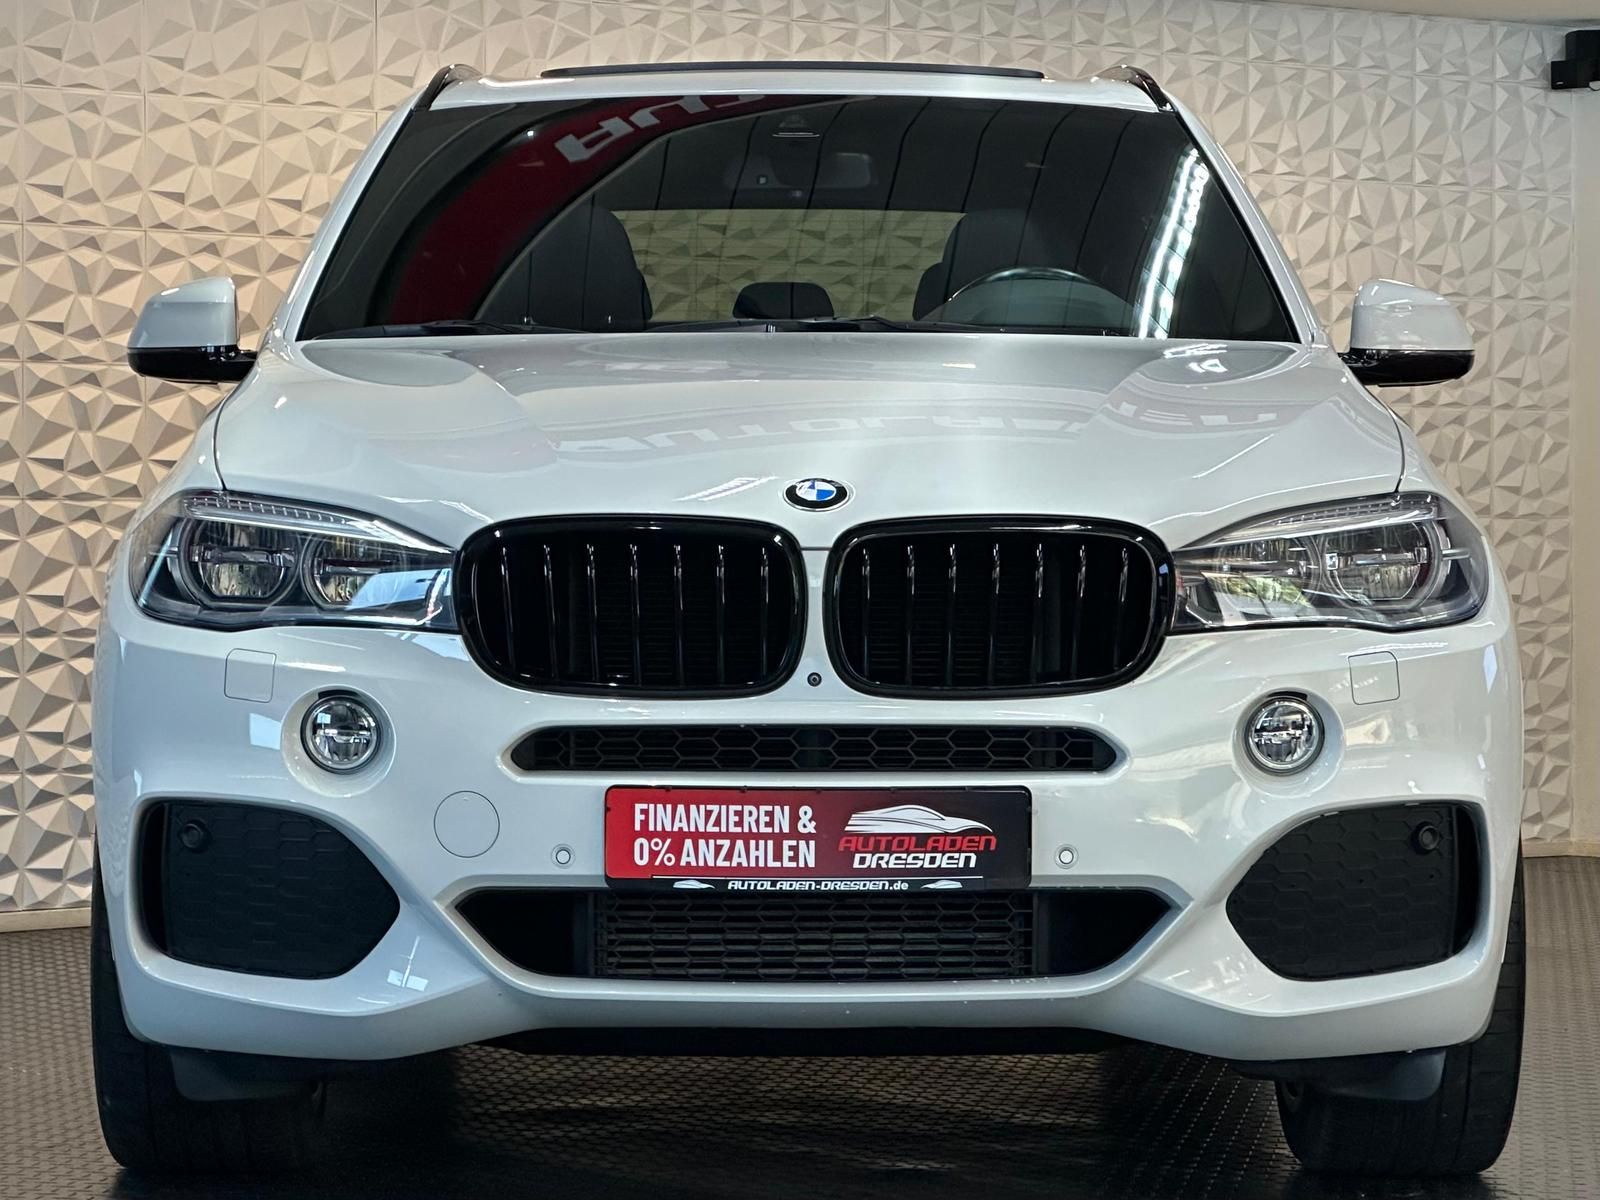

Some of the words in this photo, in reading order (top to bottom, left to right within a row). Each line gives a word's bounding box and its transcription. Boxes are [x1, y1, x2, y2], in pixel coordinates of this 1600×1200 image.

[634, 803, 790, 833] FINANZIEREN
[797, 805, 817, 834] &
[838, 835, 997, 852] AUTOLADEN
[633, 837, 676, 866] 0%
[680, 838, 816, 868] ANZAHLEN
[852, 852, 977, 869] DRESDEN
[727, 879, 909, 892] AUTOLADEN-DRESDEN.de
